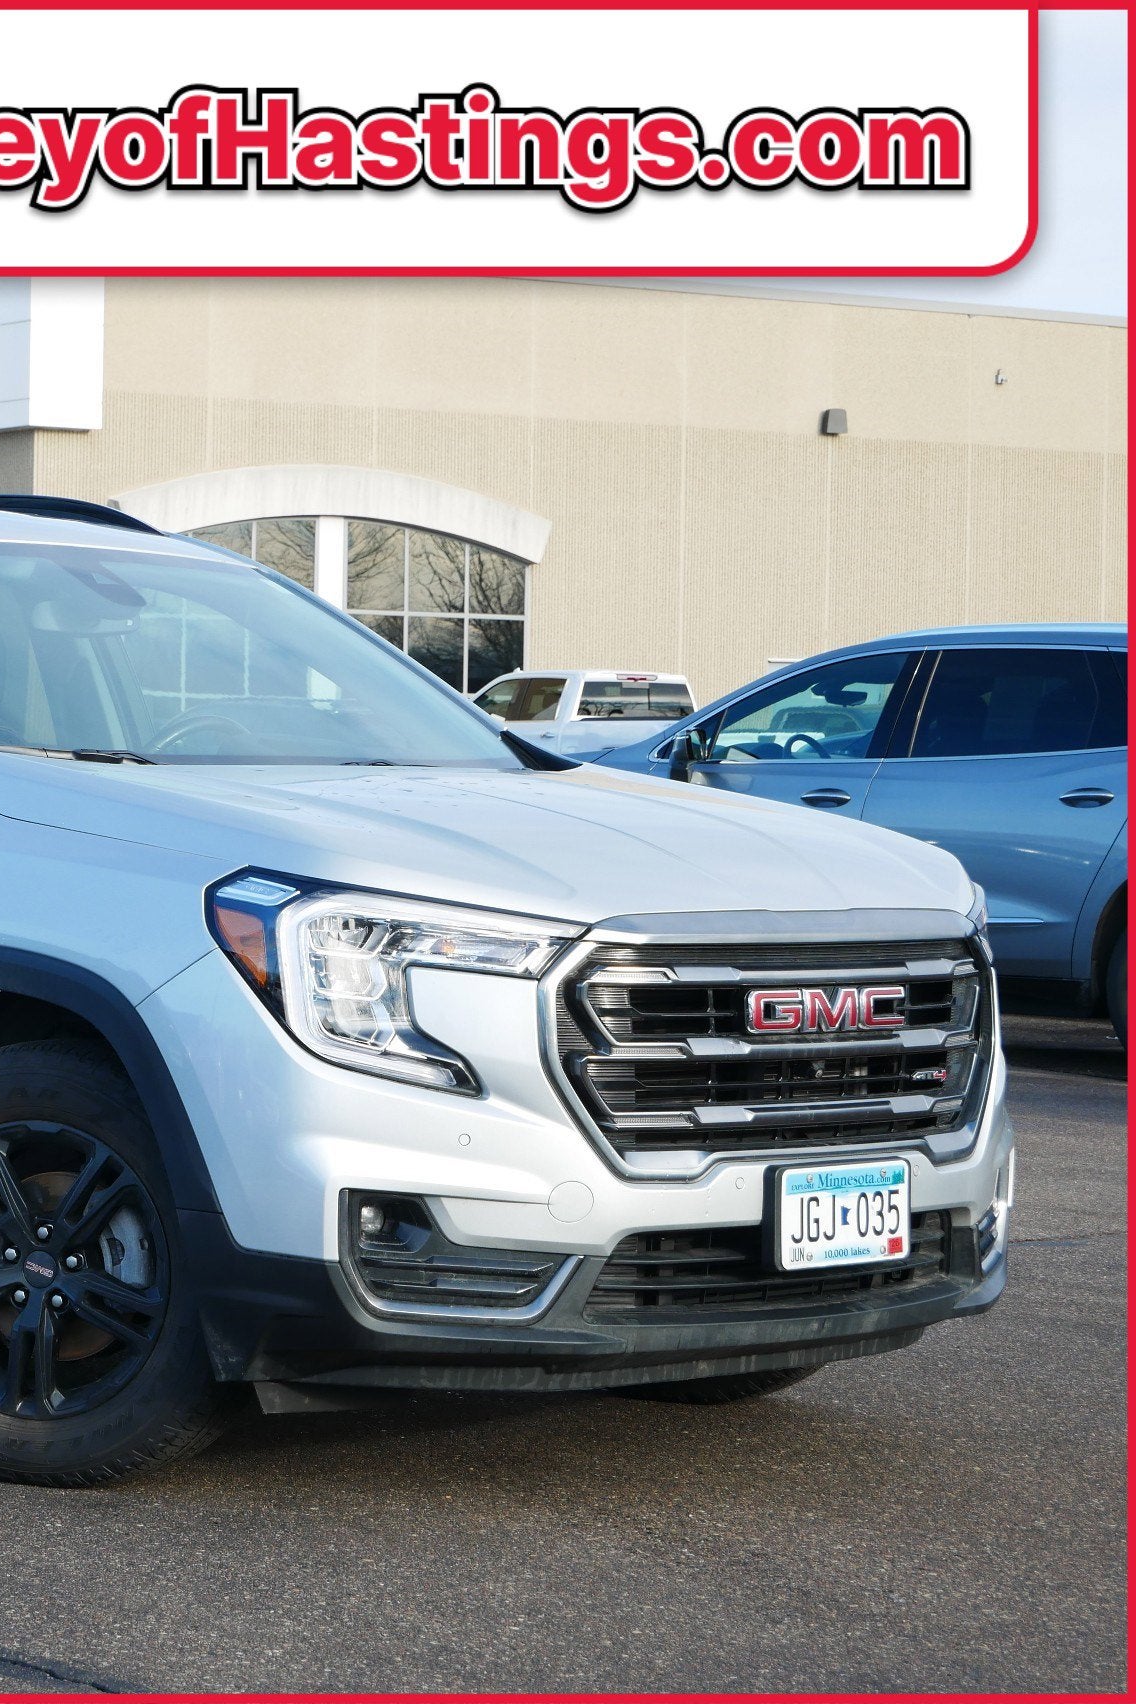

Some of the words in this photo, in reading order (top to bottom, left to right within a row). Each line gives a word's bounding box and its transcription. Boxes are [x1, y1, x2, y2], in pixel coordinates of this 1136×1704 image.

[746, 985, 906, 1034] GMC
[911, 1069, 947, 1082] AT4
[791, 1194, 836, 1244] JGJ
[856, 1188, 900, 1238] 035
[790, 1246, 805, 1262] JUN
[824, 1248, 849, 1259] 10,000
[850, 1246, 871, 1256] lakes
